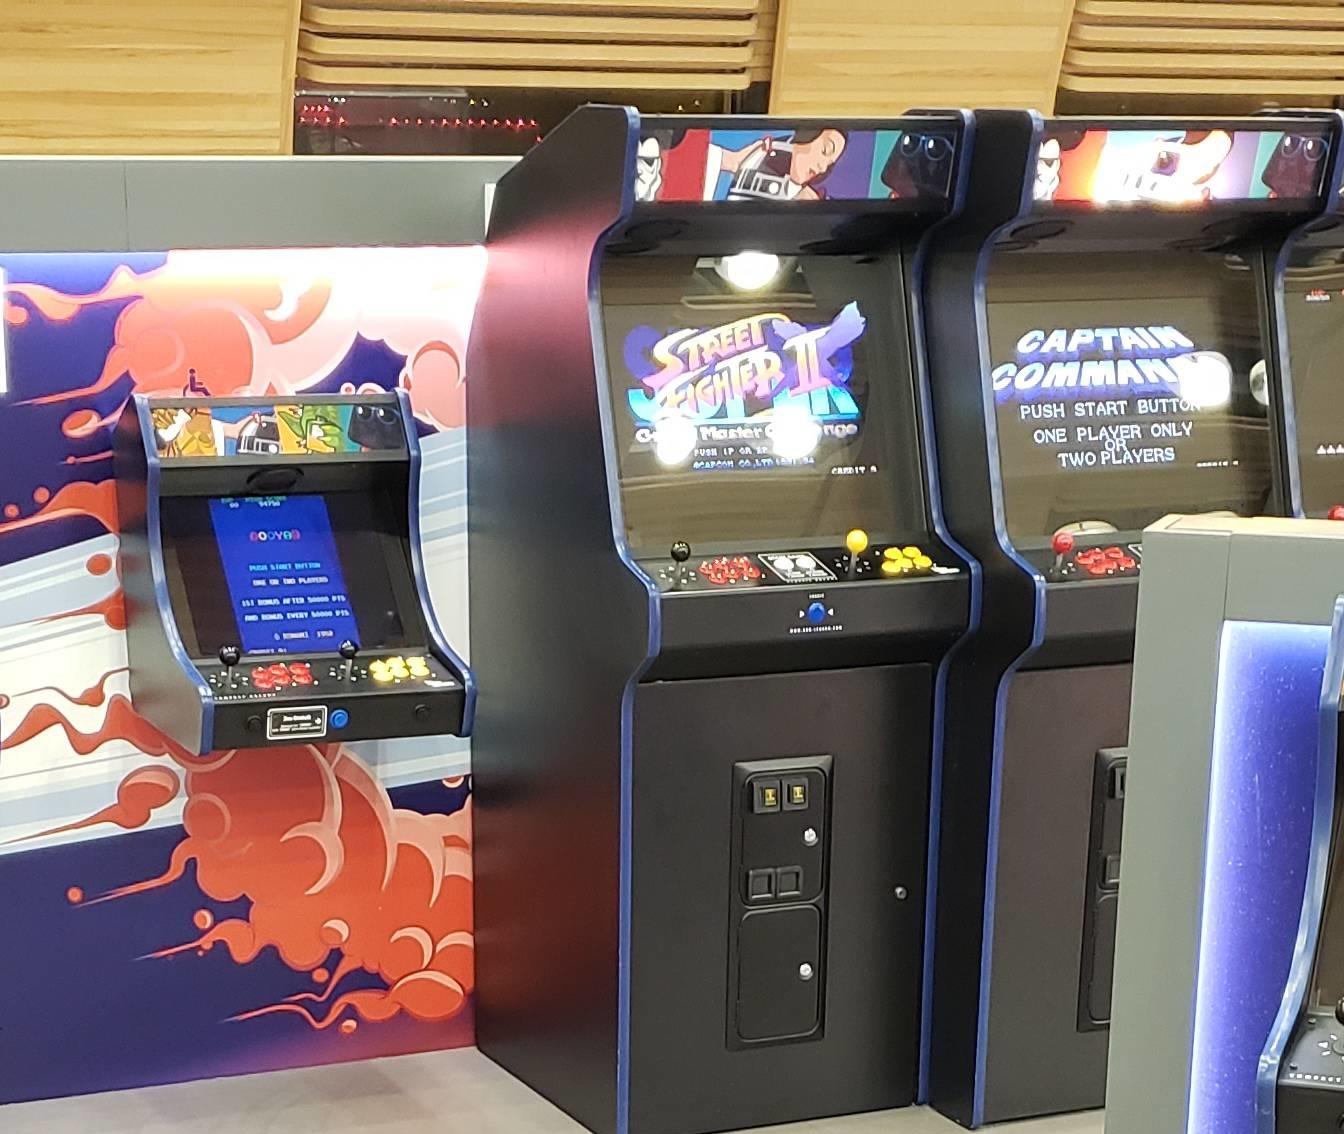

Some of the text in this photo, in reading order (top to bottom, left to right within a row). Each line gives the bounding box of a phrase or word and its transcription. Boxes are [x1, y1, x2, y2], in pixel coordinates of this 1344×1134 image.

[642, 312, 792, 389] STREET
[1016, 325, 1195, 357] CAPTAIN
[653, 345, 785, 416] FIGHTER
[1019, 397, 1202, 420] PUSH START BUTTON
[699, 424, 763, 441] Master
[1033, 422, 1193, 444] ONE PLAYER ONLY
[693, 447, 717, 457] PUSH
[1105, 438, 1127, 452] OR
[1058, 448, 1175, 467] TWO PLAYERS
